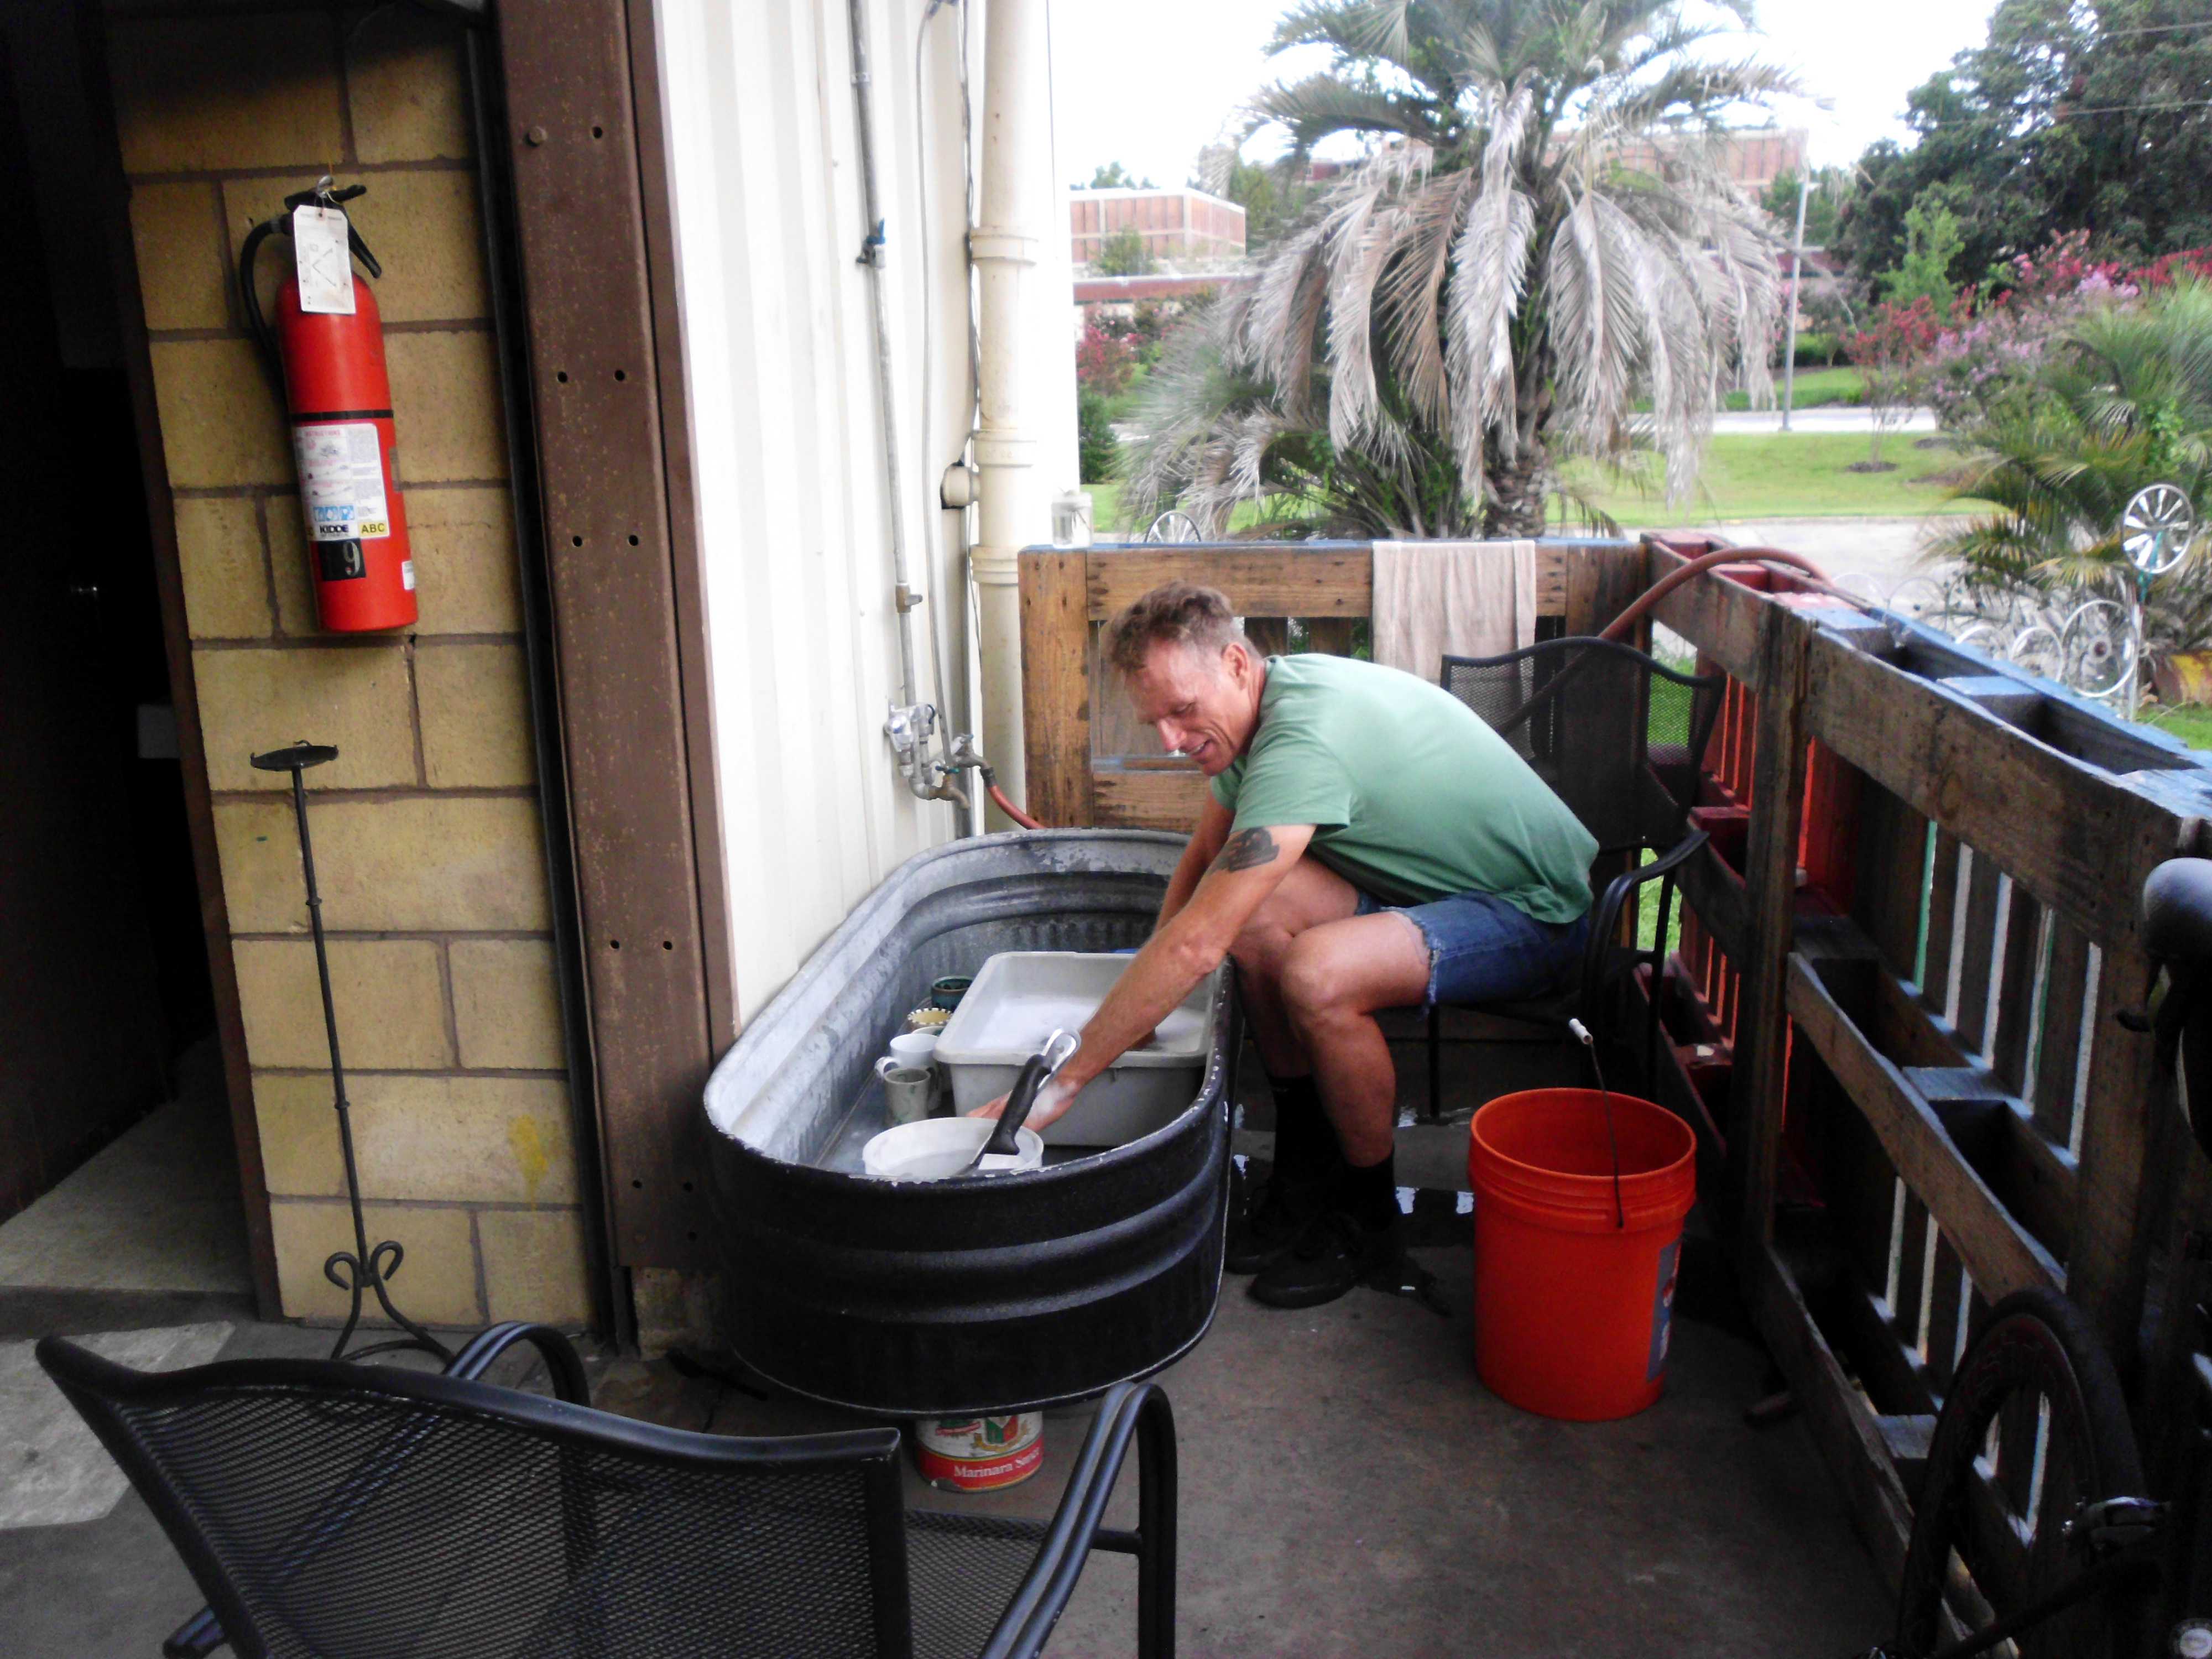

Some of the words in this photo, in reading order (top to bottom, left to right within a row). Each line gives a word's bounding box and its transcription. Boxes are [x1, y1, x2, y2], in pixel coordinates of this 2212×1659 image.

[320, 524, 349, 533] KIDDE
[361, 523, 385, 534] ABC
[954, 1463, 1013, 1478] Marinara
